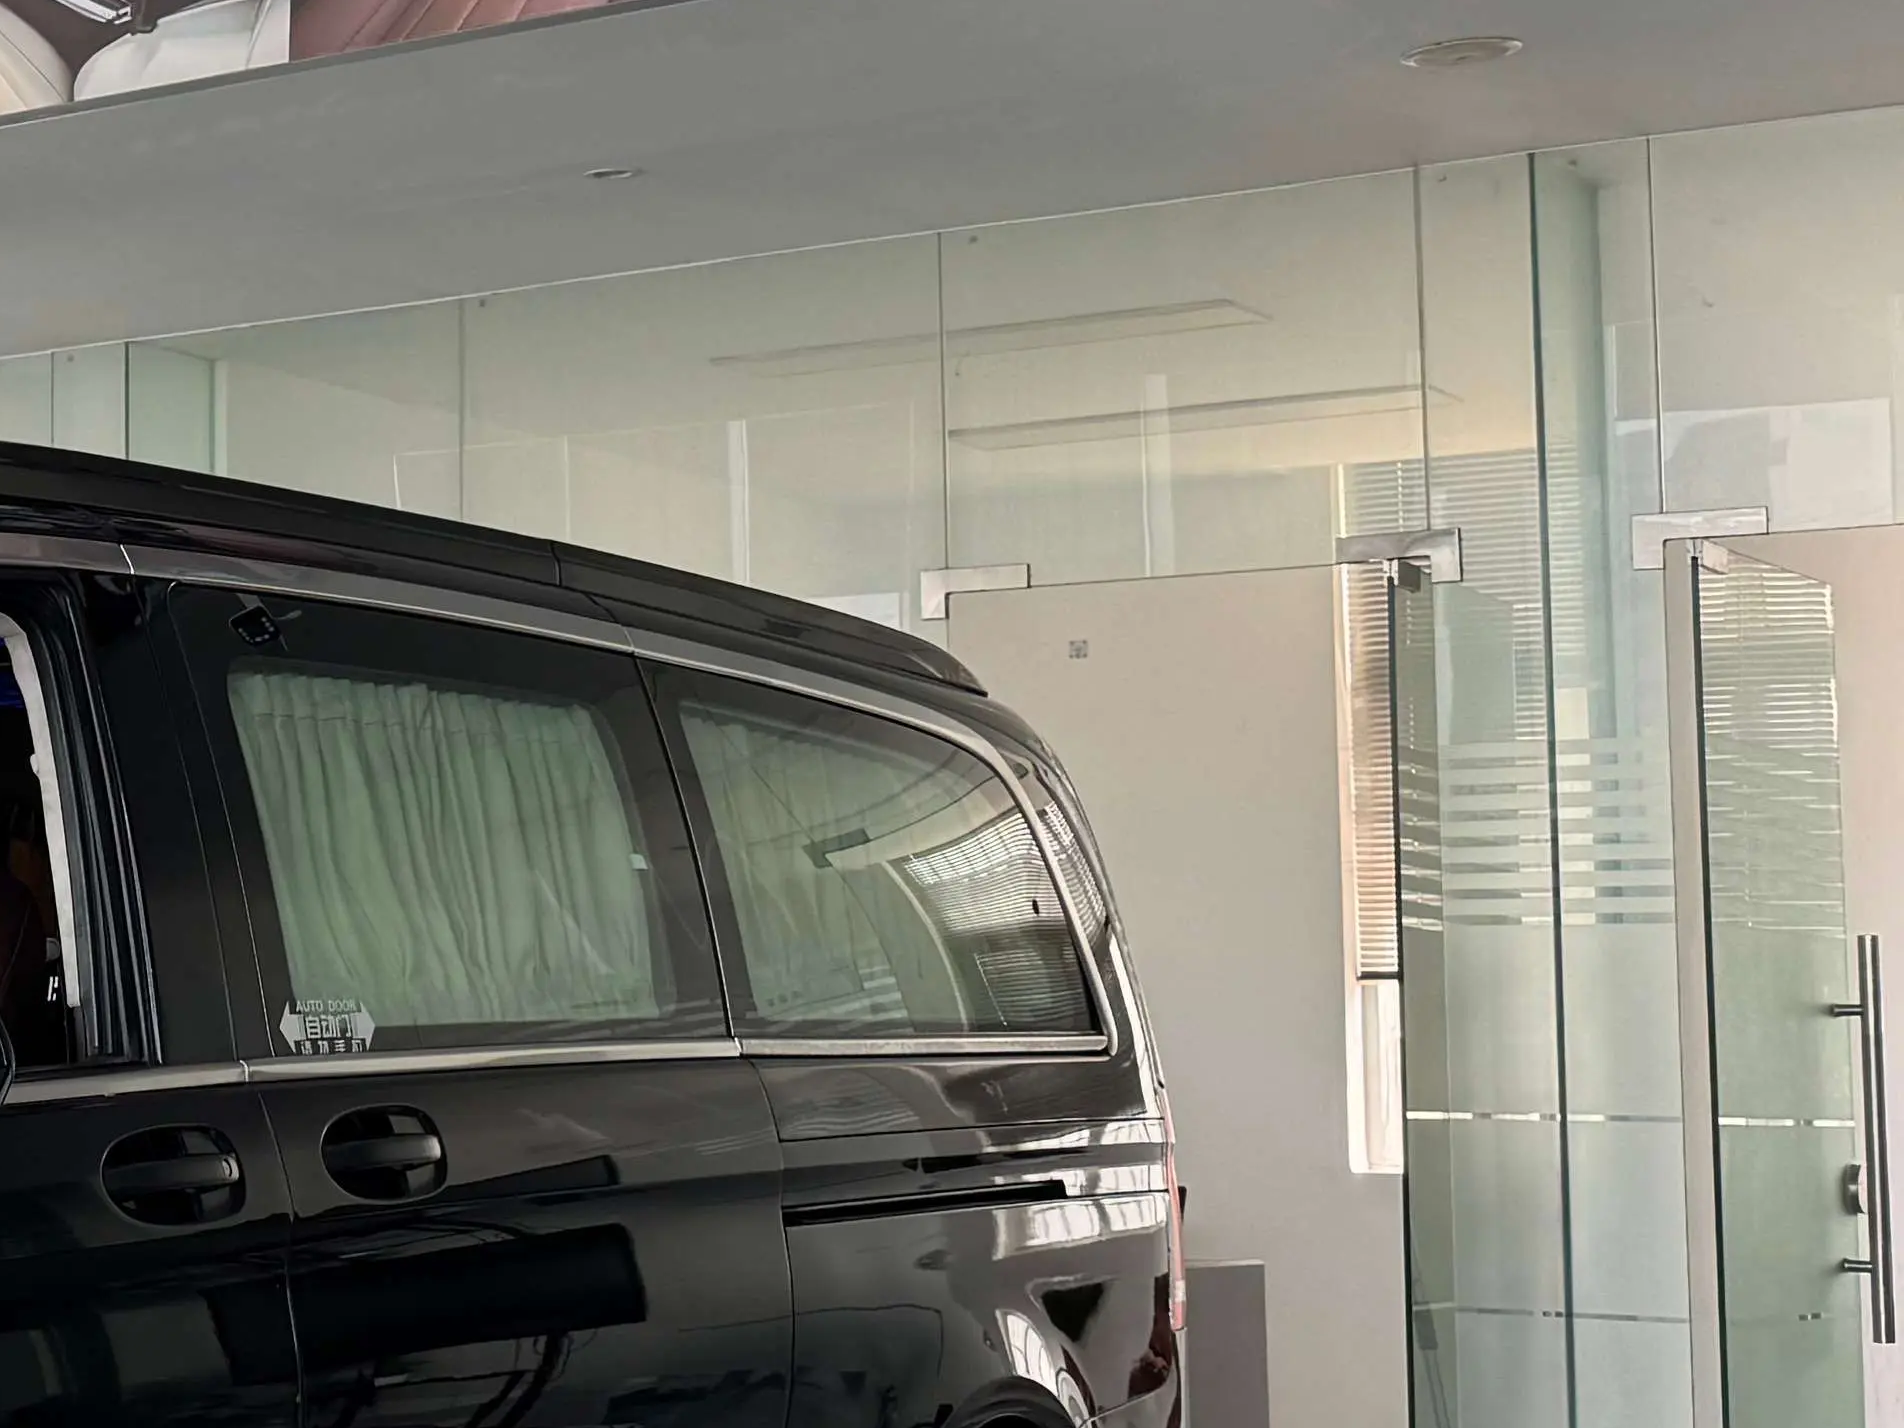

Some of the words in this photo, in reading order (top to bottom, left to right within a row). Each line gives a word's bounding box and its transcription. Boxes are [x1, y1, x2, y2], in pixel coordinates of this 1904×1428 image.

[296, 999, 324, 1013] AUTO
[328, 999, 357, 1013] DOOR
[305, 1014, 352, 1040] 自动门
